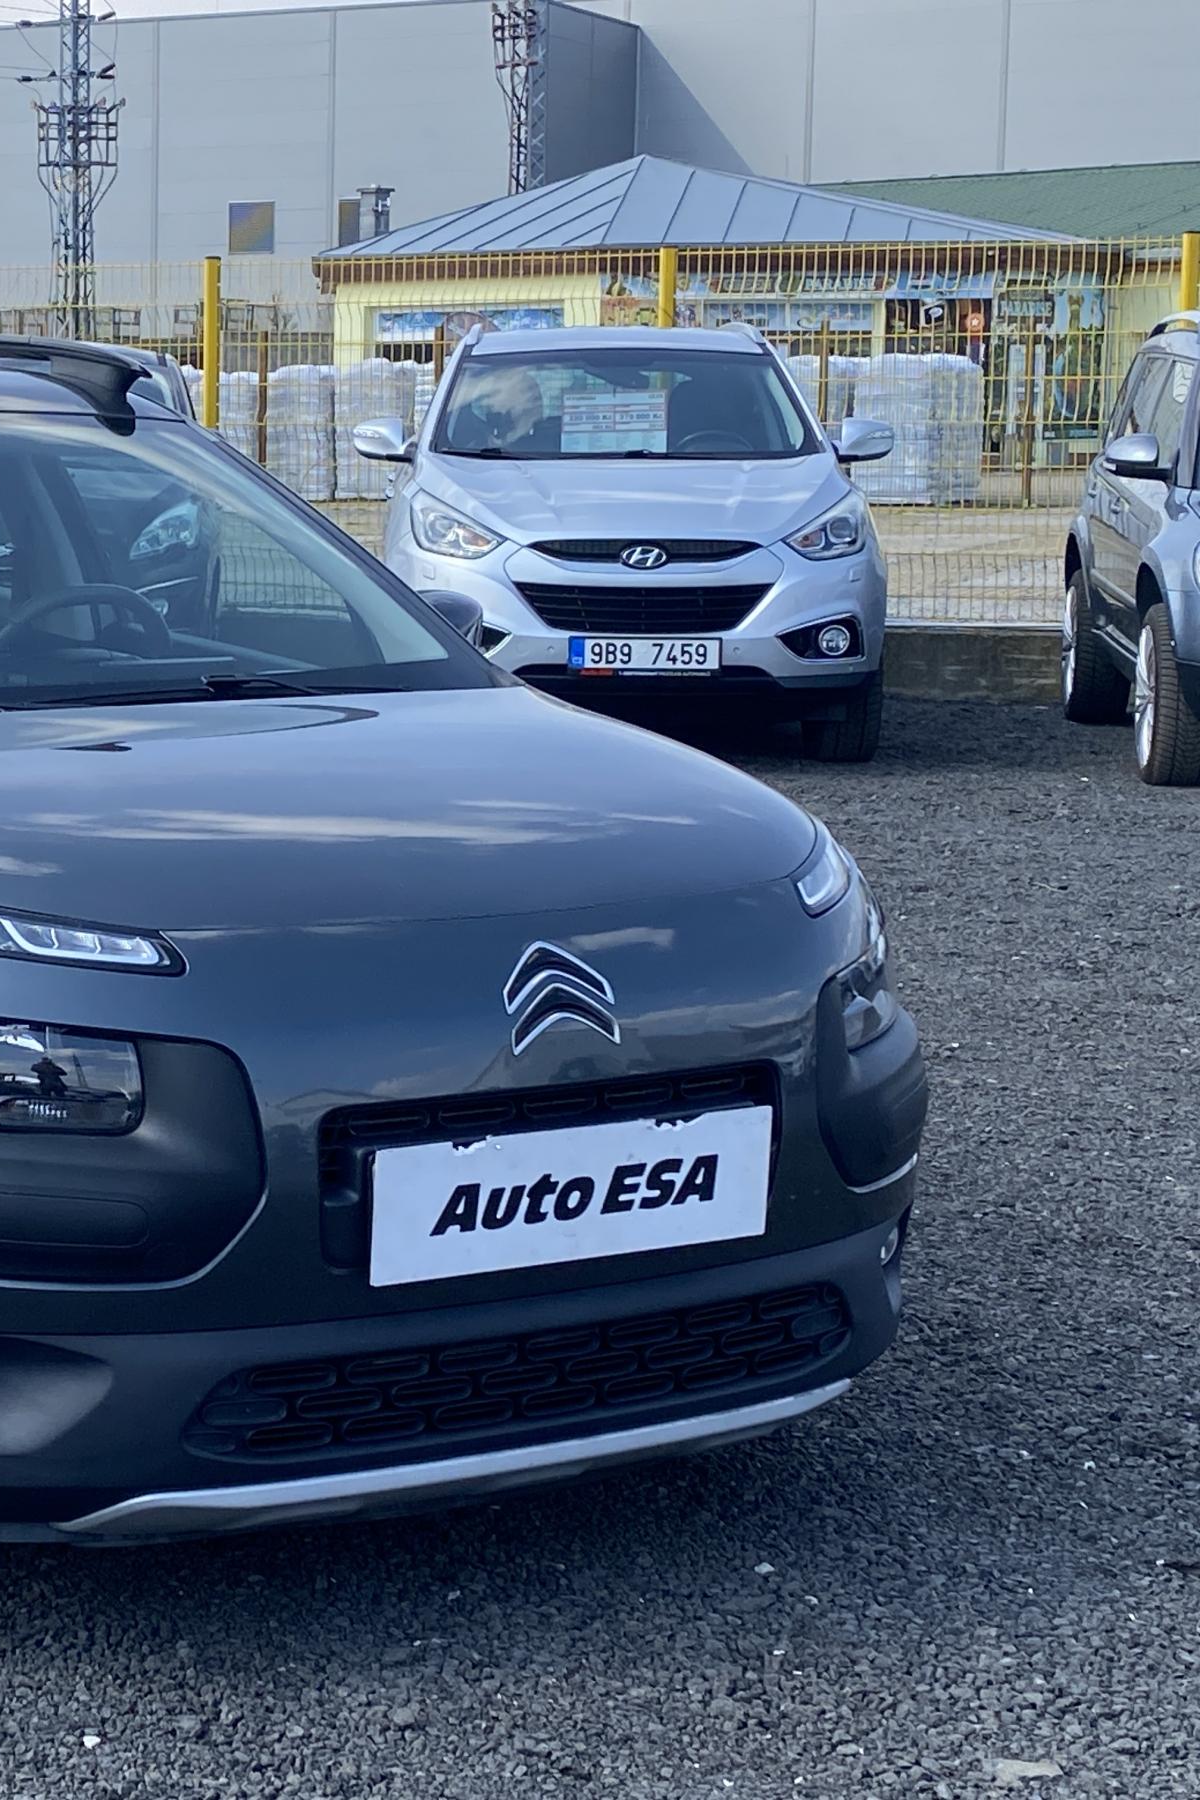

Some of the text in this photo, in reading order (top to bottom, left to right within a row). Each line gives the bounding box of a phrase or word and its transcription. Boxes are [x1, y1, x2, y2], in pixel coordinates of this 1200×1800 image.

[804, 276, 876, 290] PARADISE
[590, 642, 708, 666] 9B9 7459
[429, 1154, 719, 1237] Auto ESA
